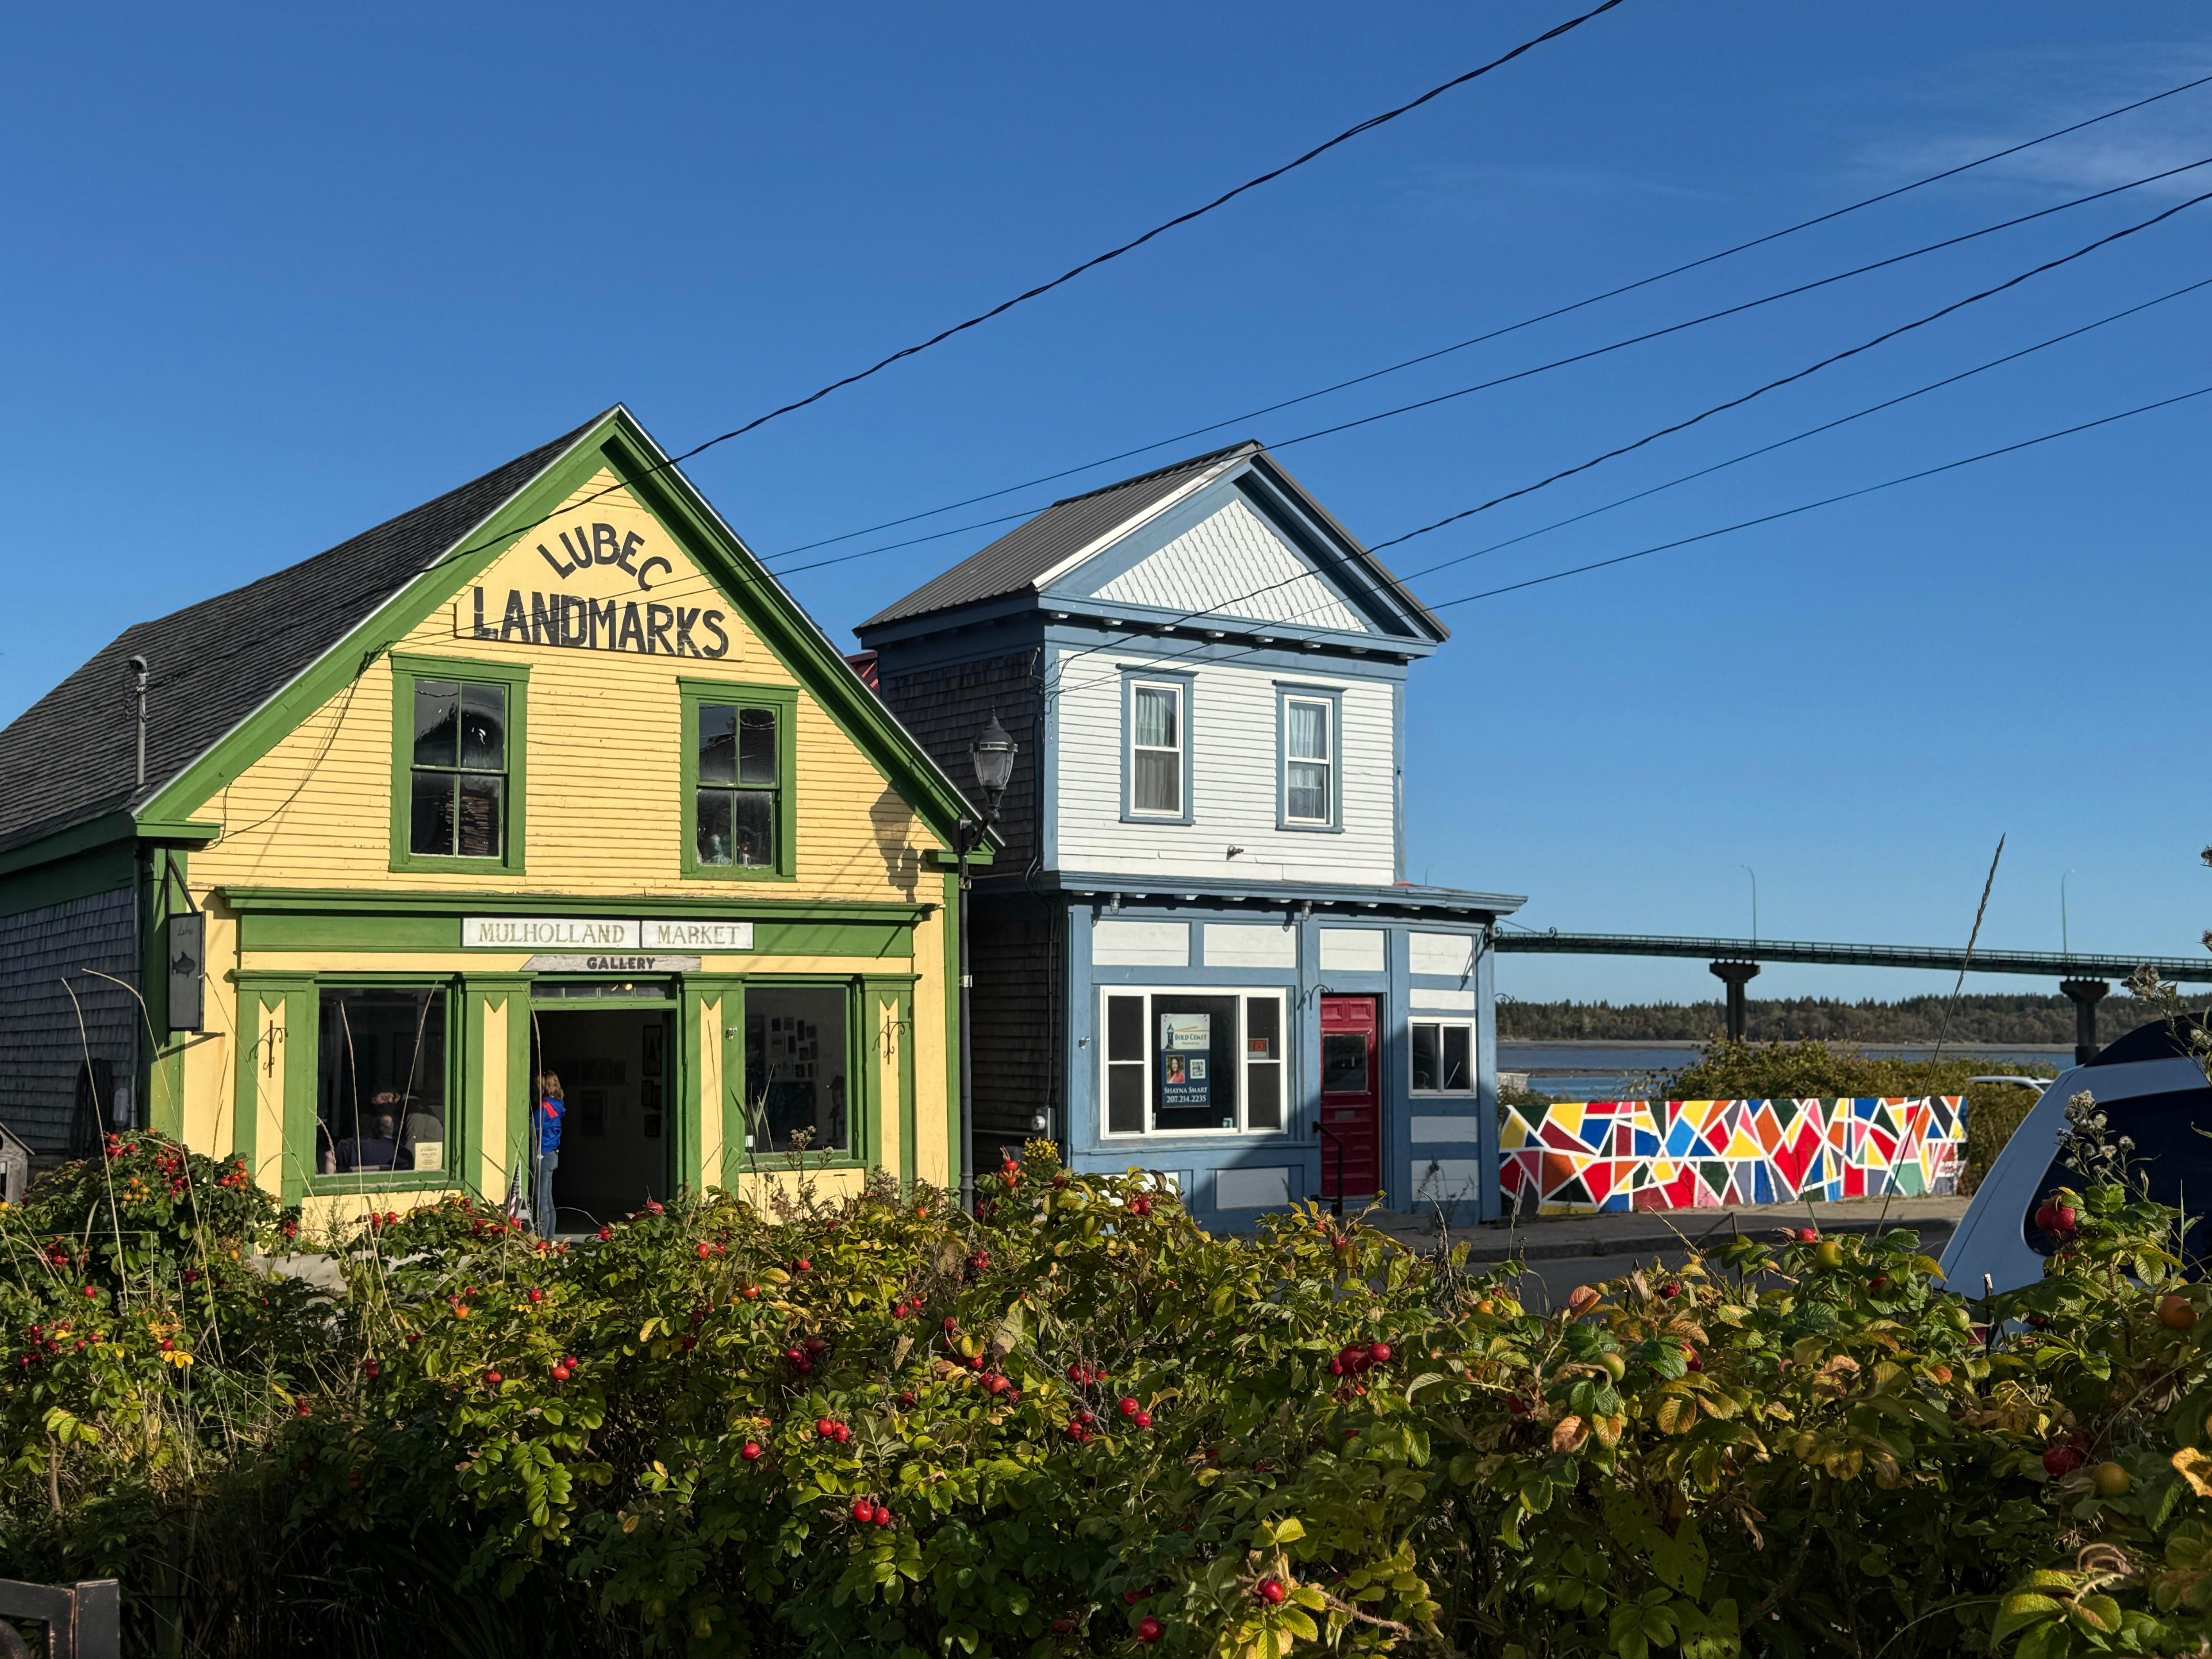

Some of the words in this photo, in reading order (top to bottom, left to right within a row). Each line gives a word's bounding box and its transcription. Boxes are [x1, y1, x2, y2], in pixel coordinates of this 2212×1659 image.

[536, 523, 672, 591] LUBEC
[473, 586, 729, 658] LANDMARKS
[479, 923, 625, 943] MULHOLLAND
[657, 925, 741, 945] MARKET
[587, 956, 656, 970] GALLERY
[1167, 1094, 1206, 1103] 207.214.2235
